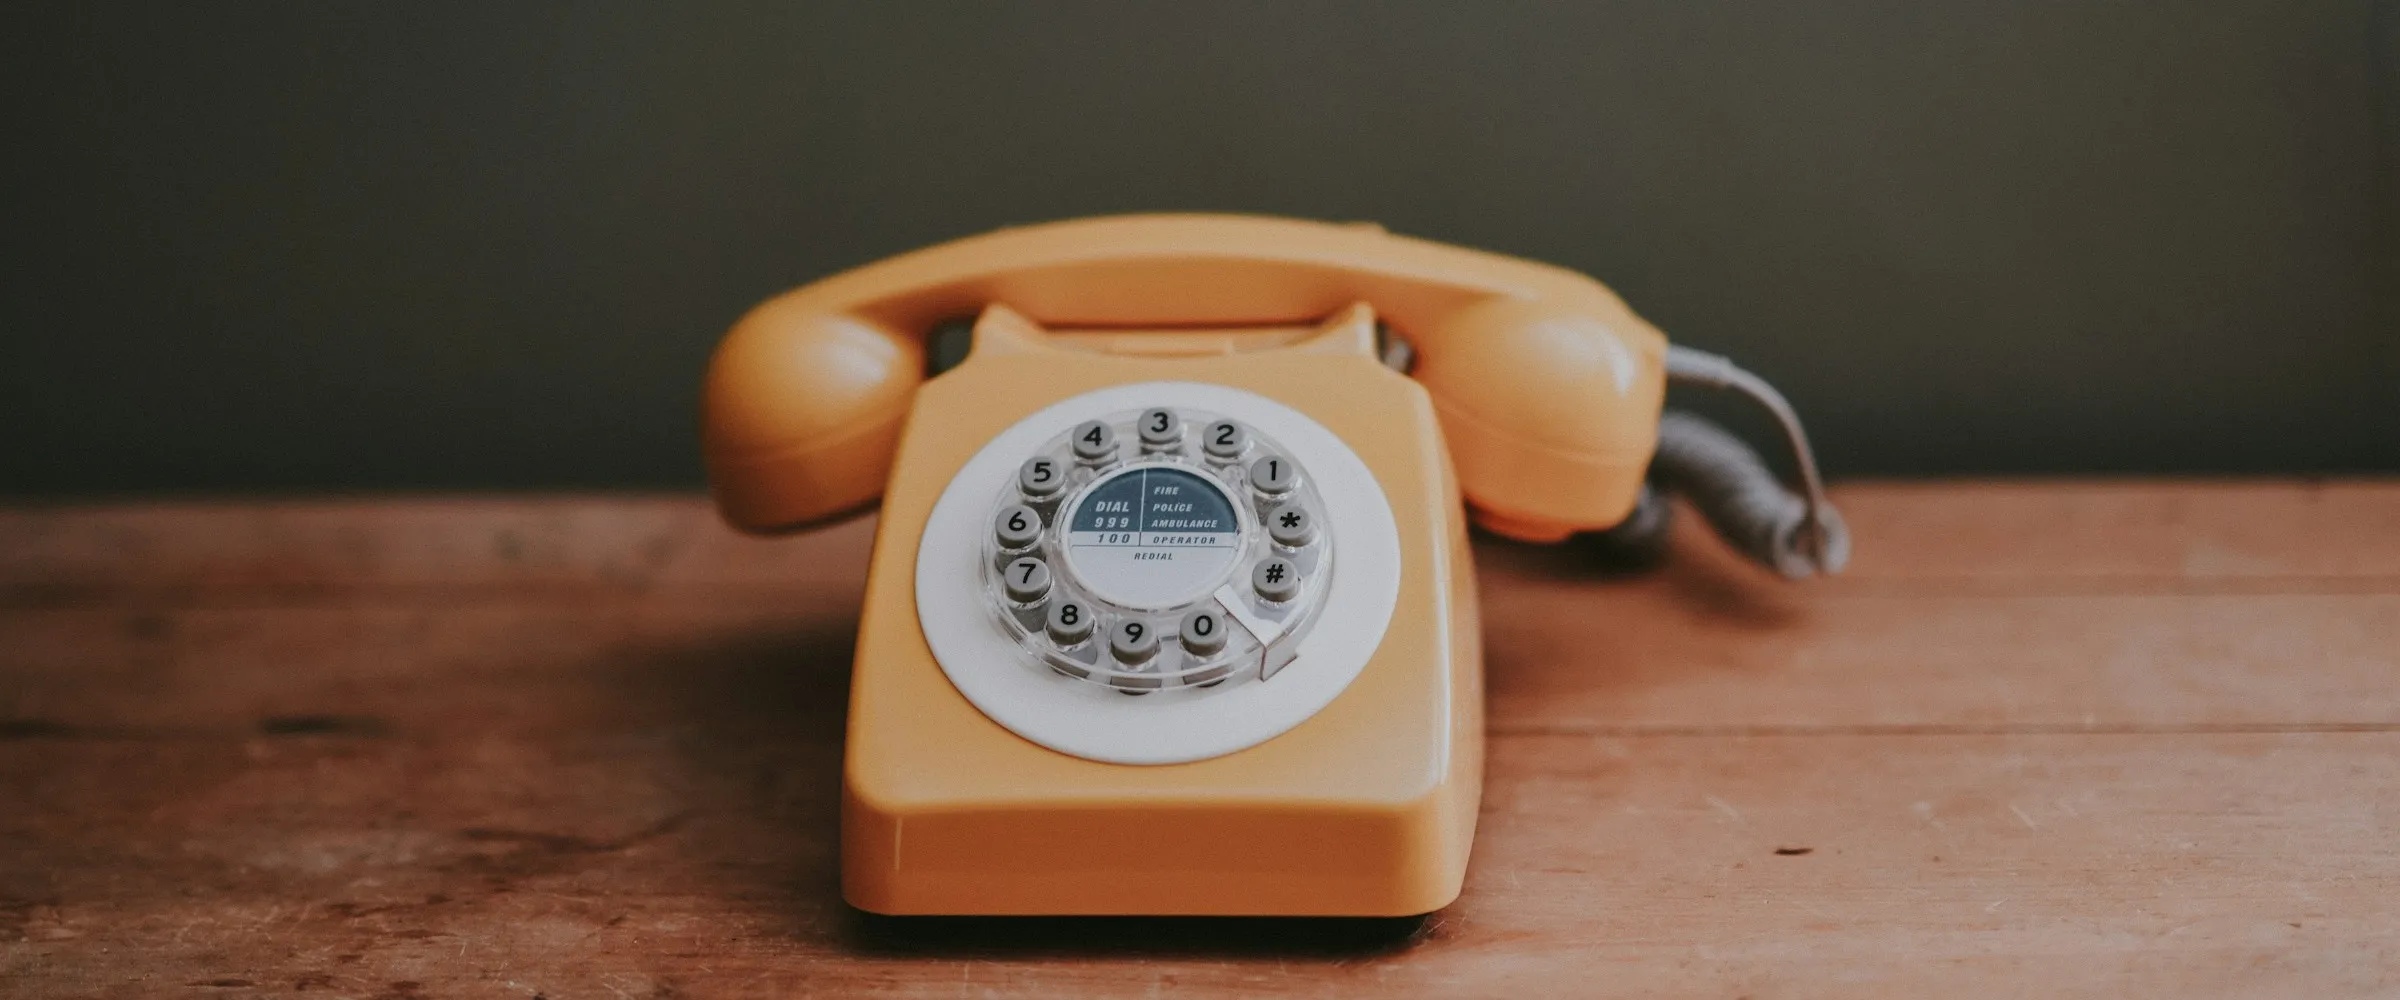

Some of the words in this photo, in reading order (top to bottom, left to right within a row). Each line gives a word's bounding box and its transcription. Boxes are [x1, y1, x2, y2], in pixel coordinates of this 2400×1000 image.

[1150, 411, 1169, 434] 3
[1082, 426, 1103, 447] 4
[1215, 424, 1235, 446] 2
[1033, 461, 1052, 483] 5
[1269, 460, 1278, 482] 1
[1154, 486, 1180, 495] FIRE
[1096, 501, 1130, 512] DIAL
[1152, 503, 1193, 512] POLICE
[1007, 510, 1027, 532] 6
[1151, 519, 1218, 528] AMBULANCE
[1153, 536, 1216, 544] OPERATOR
[1134, 552, 1173, 560] REDIAL
[1018, 562, 1037, 585] 7
[1265, 563, 1284, 584] #
[1060, 603, 1079, 626] 8
[1193, 614, 1213, 637] 0
[1124, 622, 1144, 644] 9
